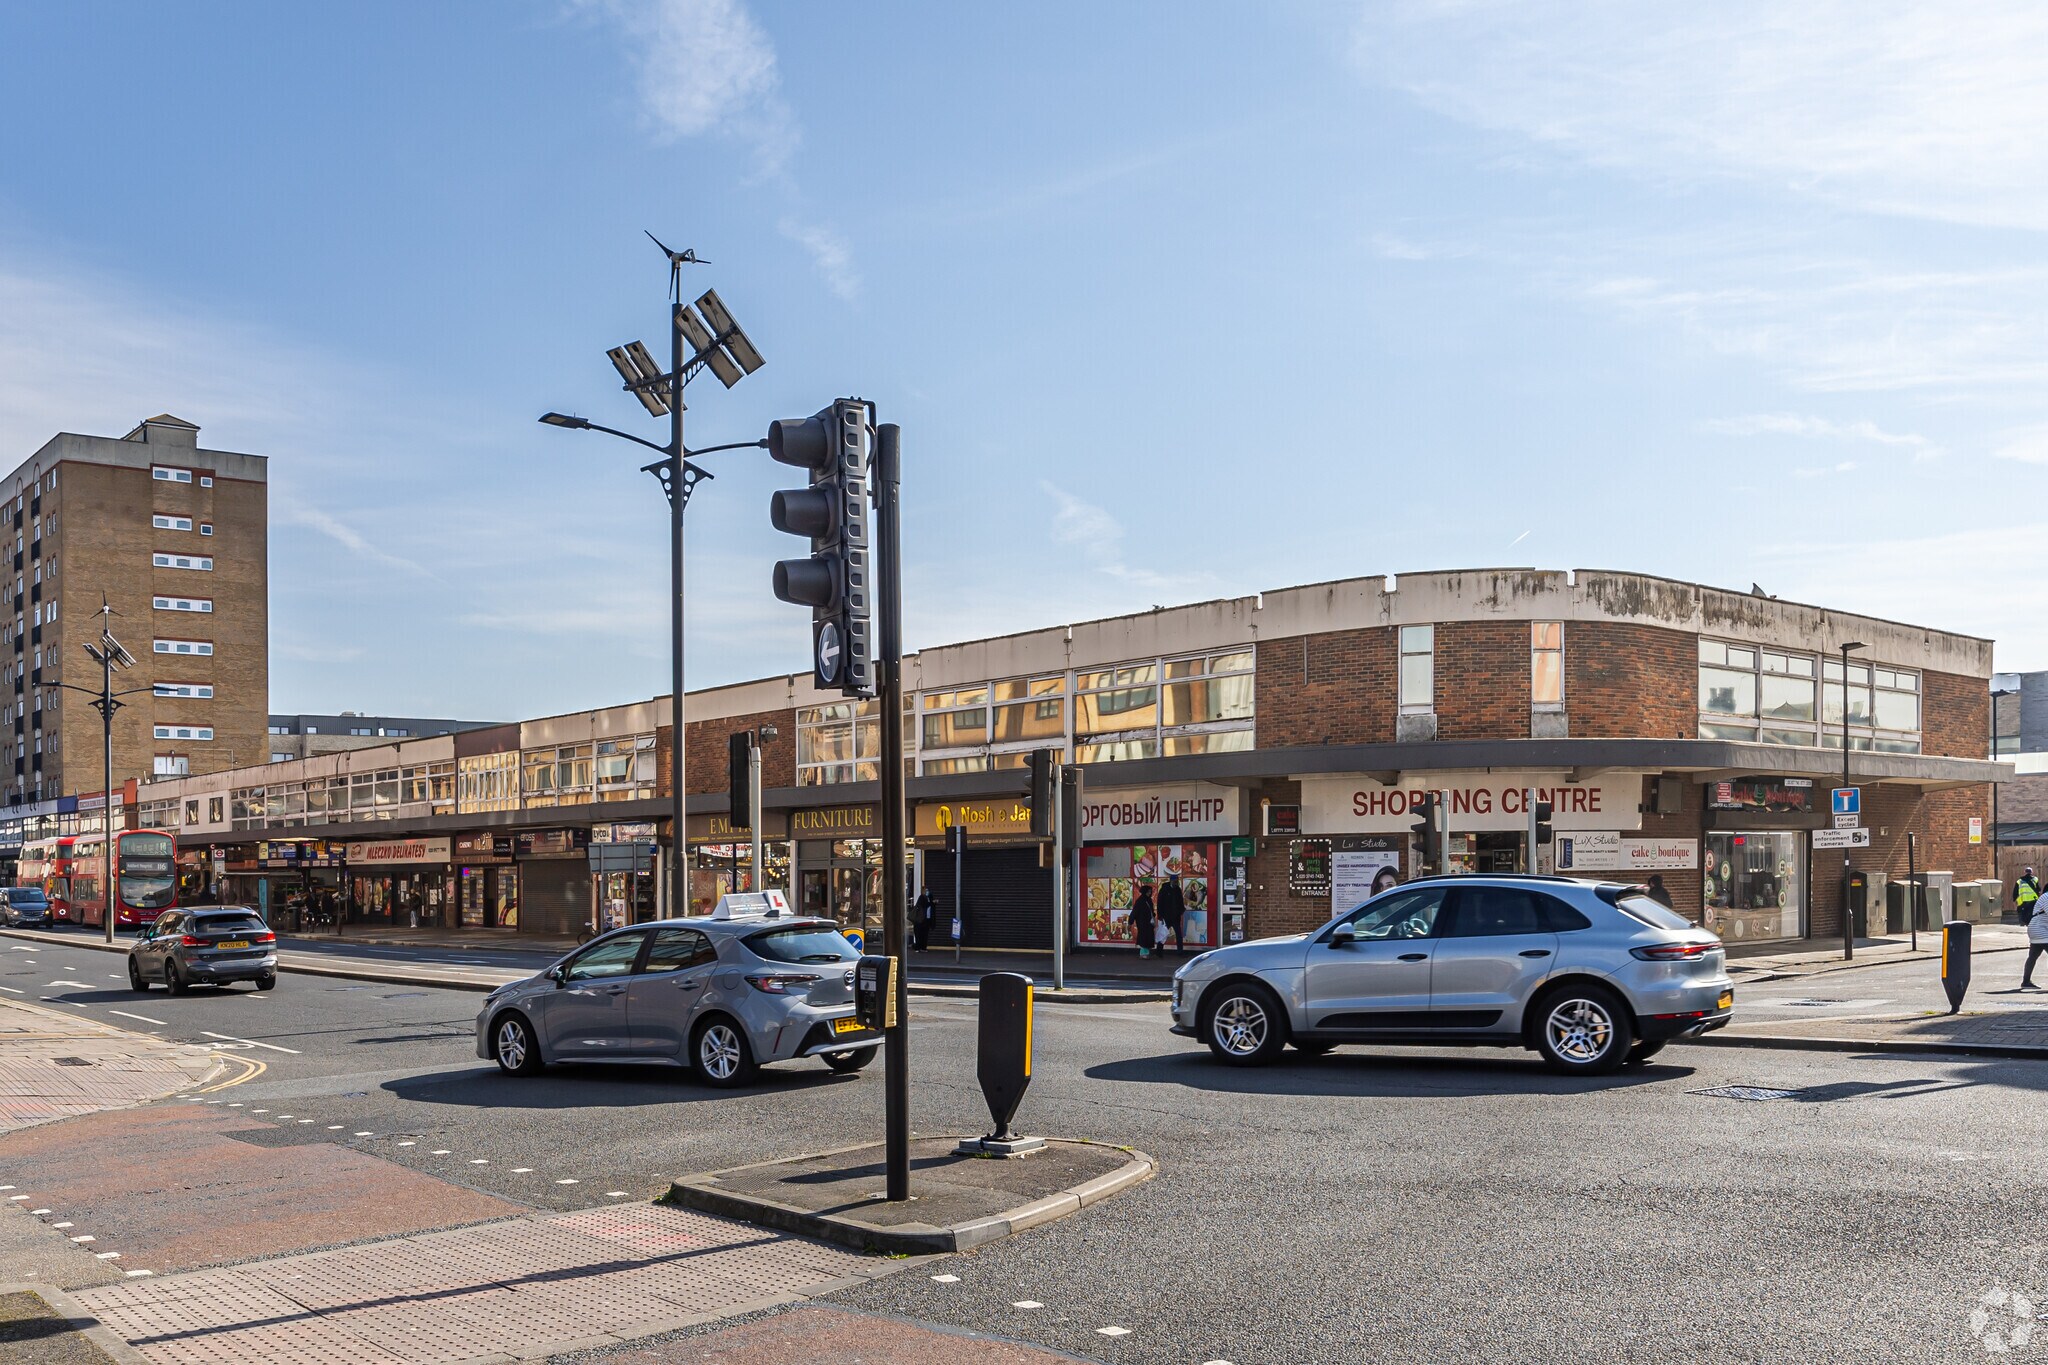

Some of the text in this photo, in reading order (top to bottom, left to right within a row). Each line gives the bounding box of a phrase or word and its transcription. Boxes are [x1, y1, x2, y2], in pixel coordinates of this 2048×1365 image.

[1353, 788, 1492, 816] SHOPNG
[793, 808, 873, 830] FURNITURE
[960, 805, 995, 824] Nosh
[1083, 796, 1224, 828] ОРГОВЫЙ ЦЕНТР
[1360, 838, 1388, 848] Studio
[1594, 834, 1619, 844] Studio
[392, 844, 426, 859] DELIKATESY
[1631, 845, 1690, 860] cake boutique
[1297, 862, 1305, 871] &
[772, 895, 783, 907] L
